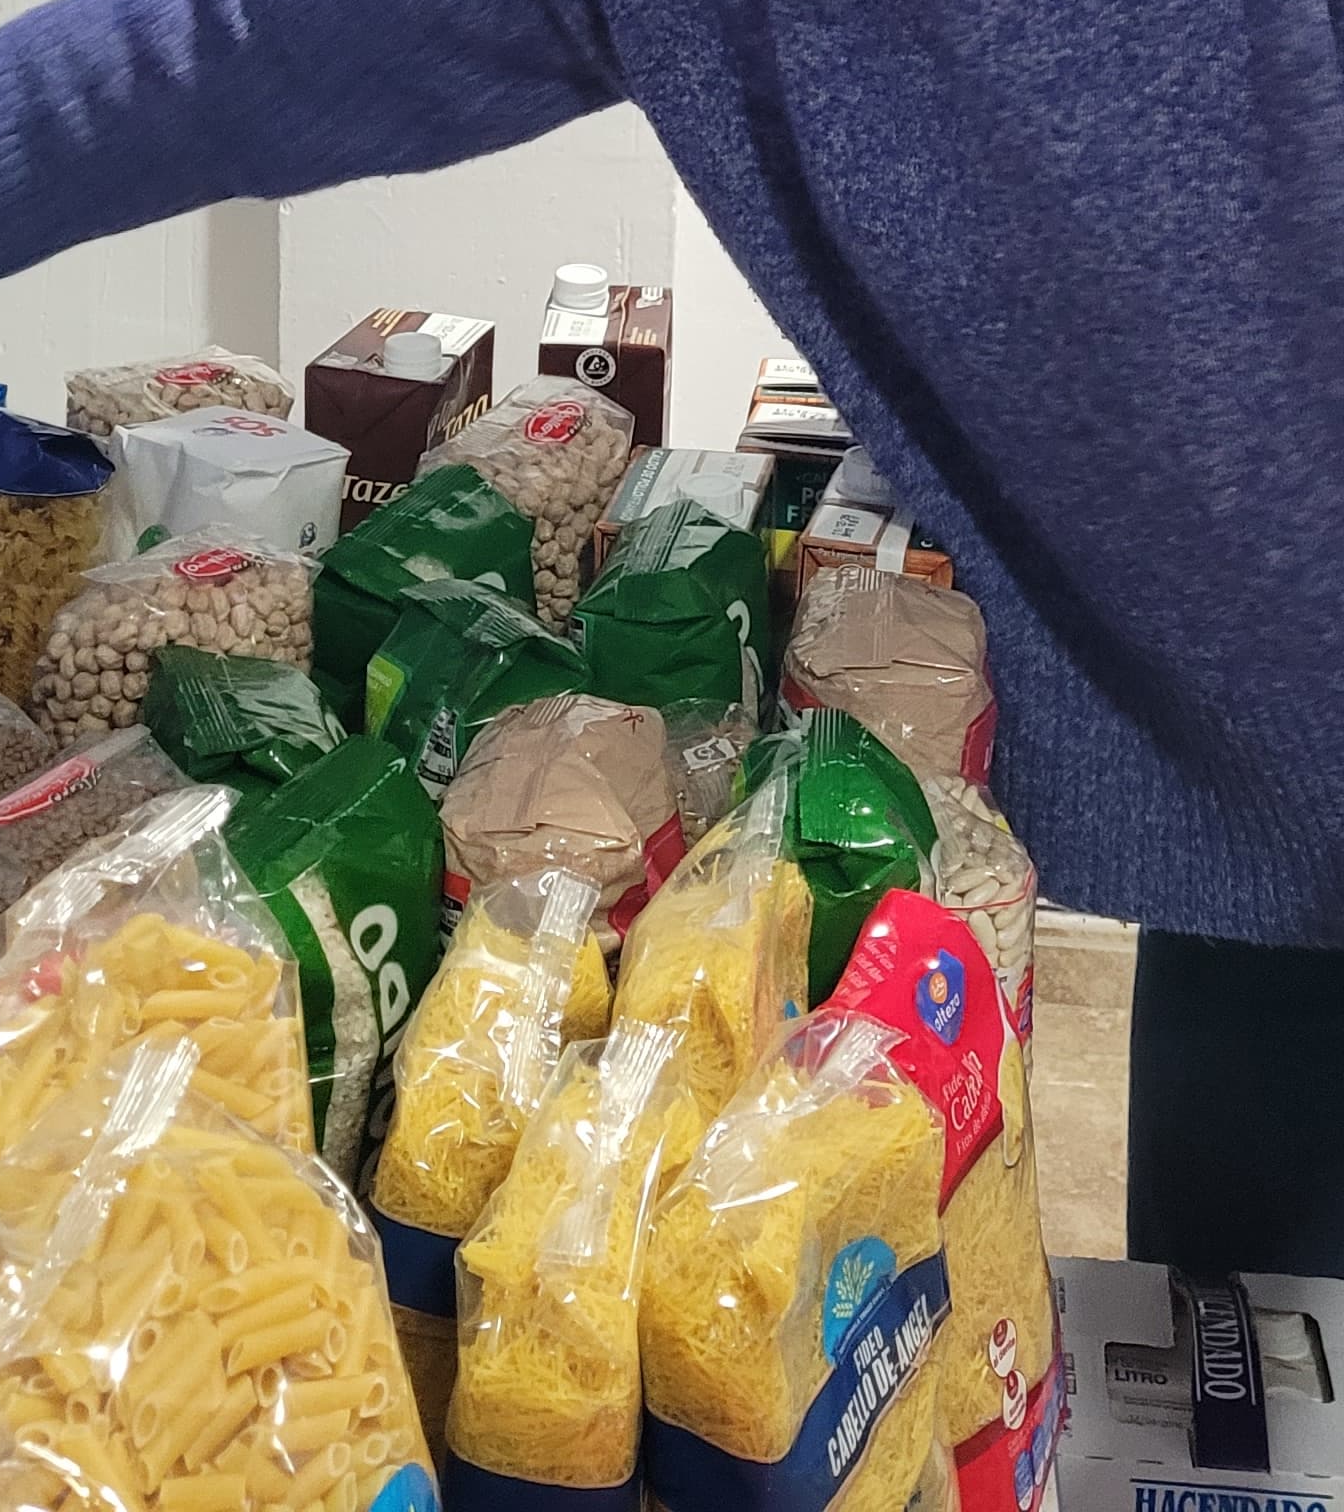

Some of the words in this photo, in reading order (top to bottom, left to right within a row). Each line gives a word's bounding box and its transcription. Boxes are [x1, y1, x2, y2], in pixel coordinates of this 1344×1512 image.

[212, 416, 288, 437] SOS
[853, 1325, 885, 1376] FIDEO
[1114, 1369, 1169, 1386] LITRO
[827, 1373, 877, 1478] CABELLO
[871, 1346, 898, 1399] DE
